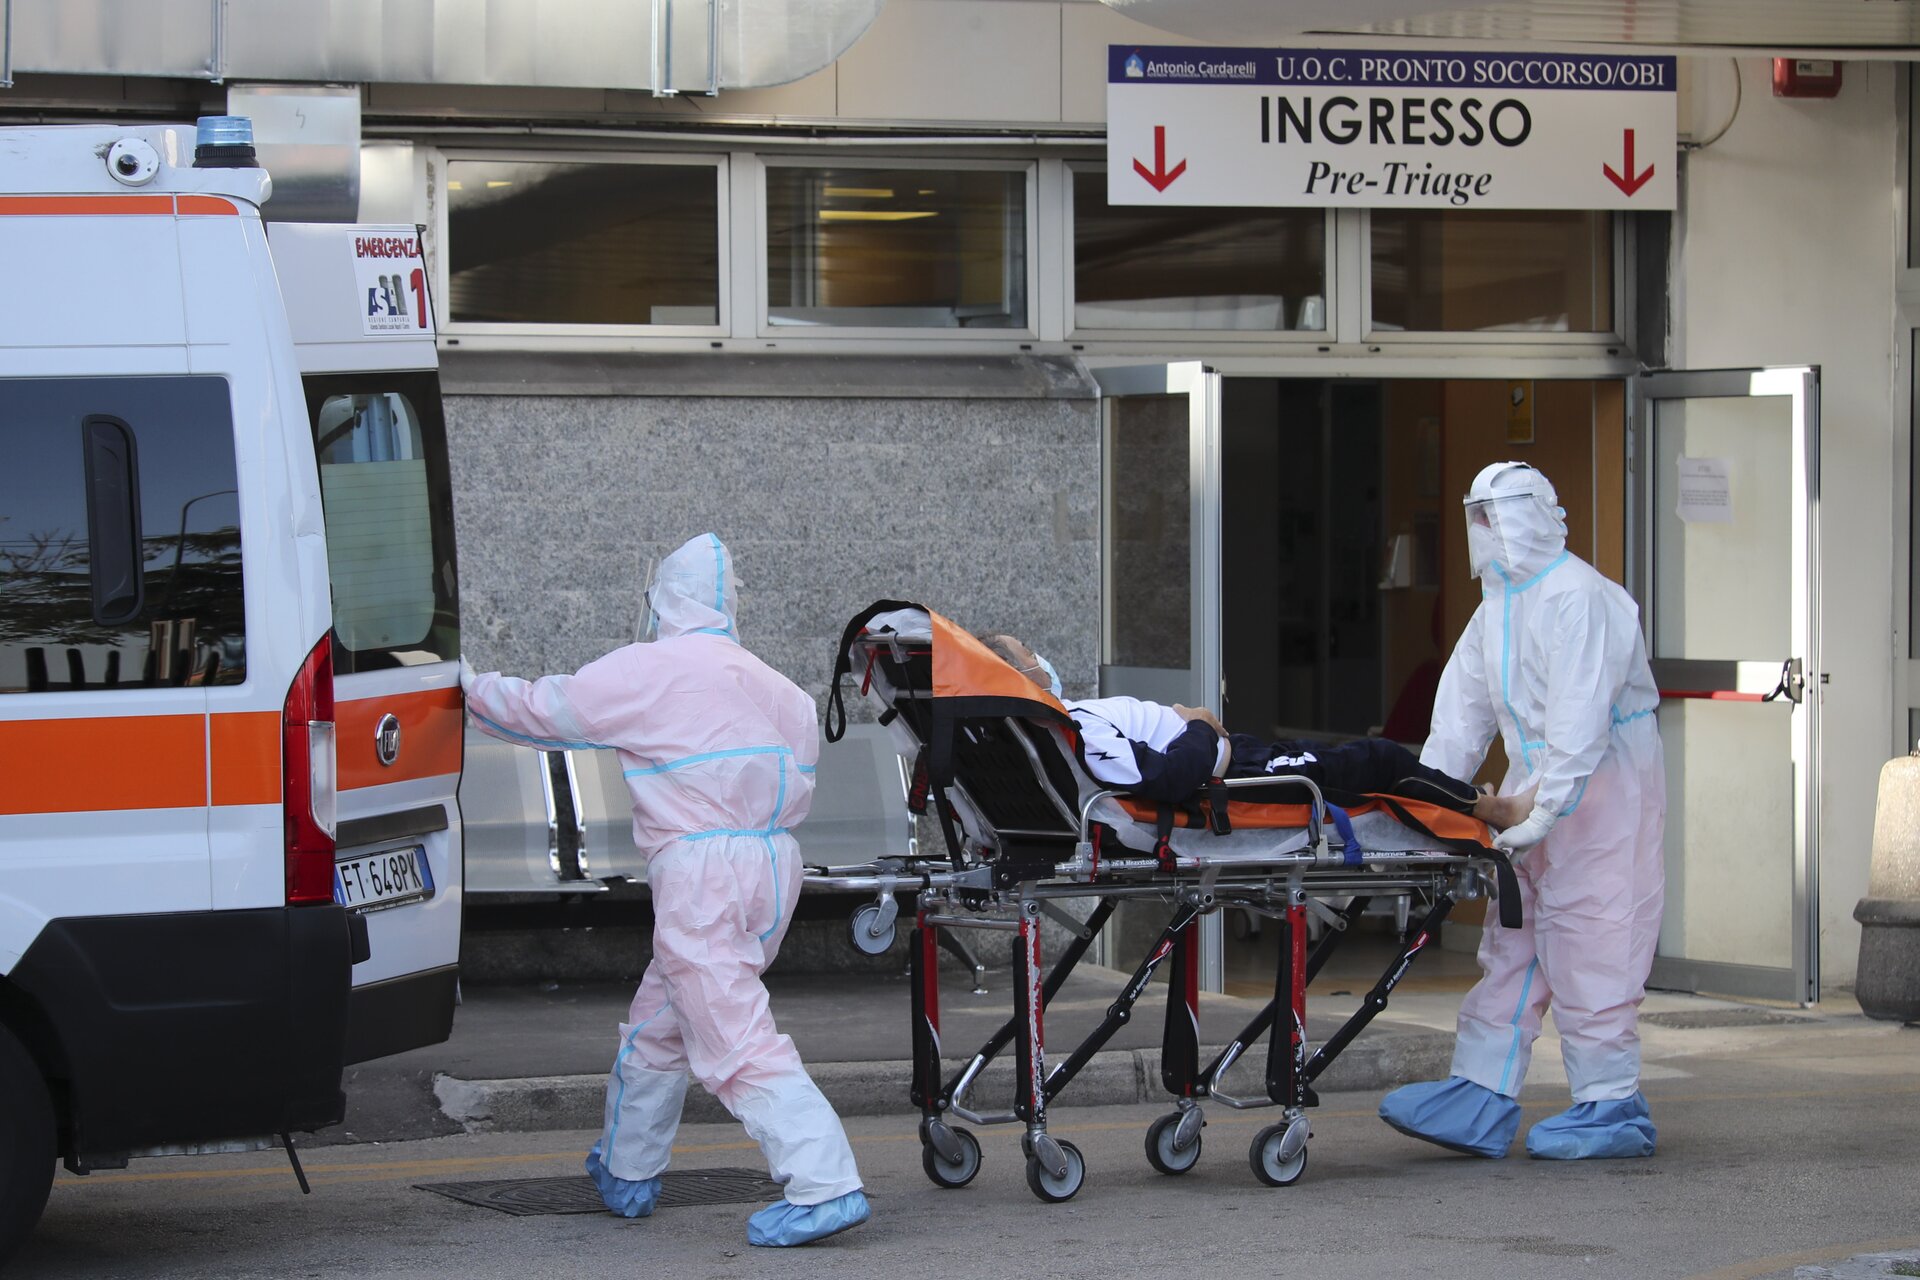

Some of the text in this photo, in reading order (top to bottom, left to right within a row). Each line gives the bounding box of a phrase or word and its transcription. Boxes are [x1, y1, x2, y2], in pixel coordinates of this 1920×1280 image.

[1147, 60, 1256, 75] Antonio Cardarelli
[1276, 57, 1664, 86] U.O.C. PRONTO SOCCORSO/OBI
[1261, 96, 1532, 147] INGRESSO
[1303, 161, 1492, 205] Pre-Triage
[340, 863, 366, 902] FT
[368, 852, 422, 896] 648PK
